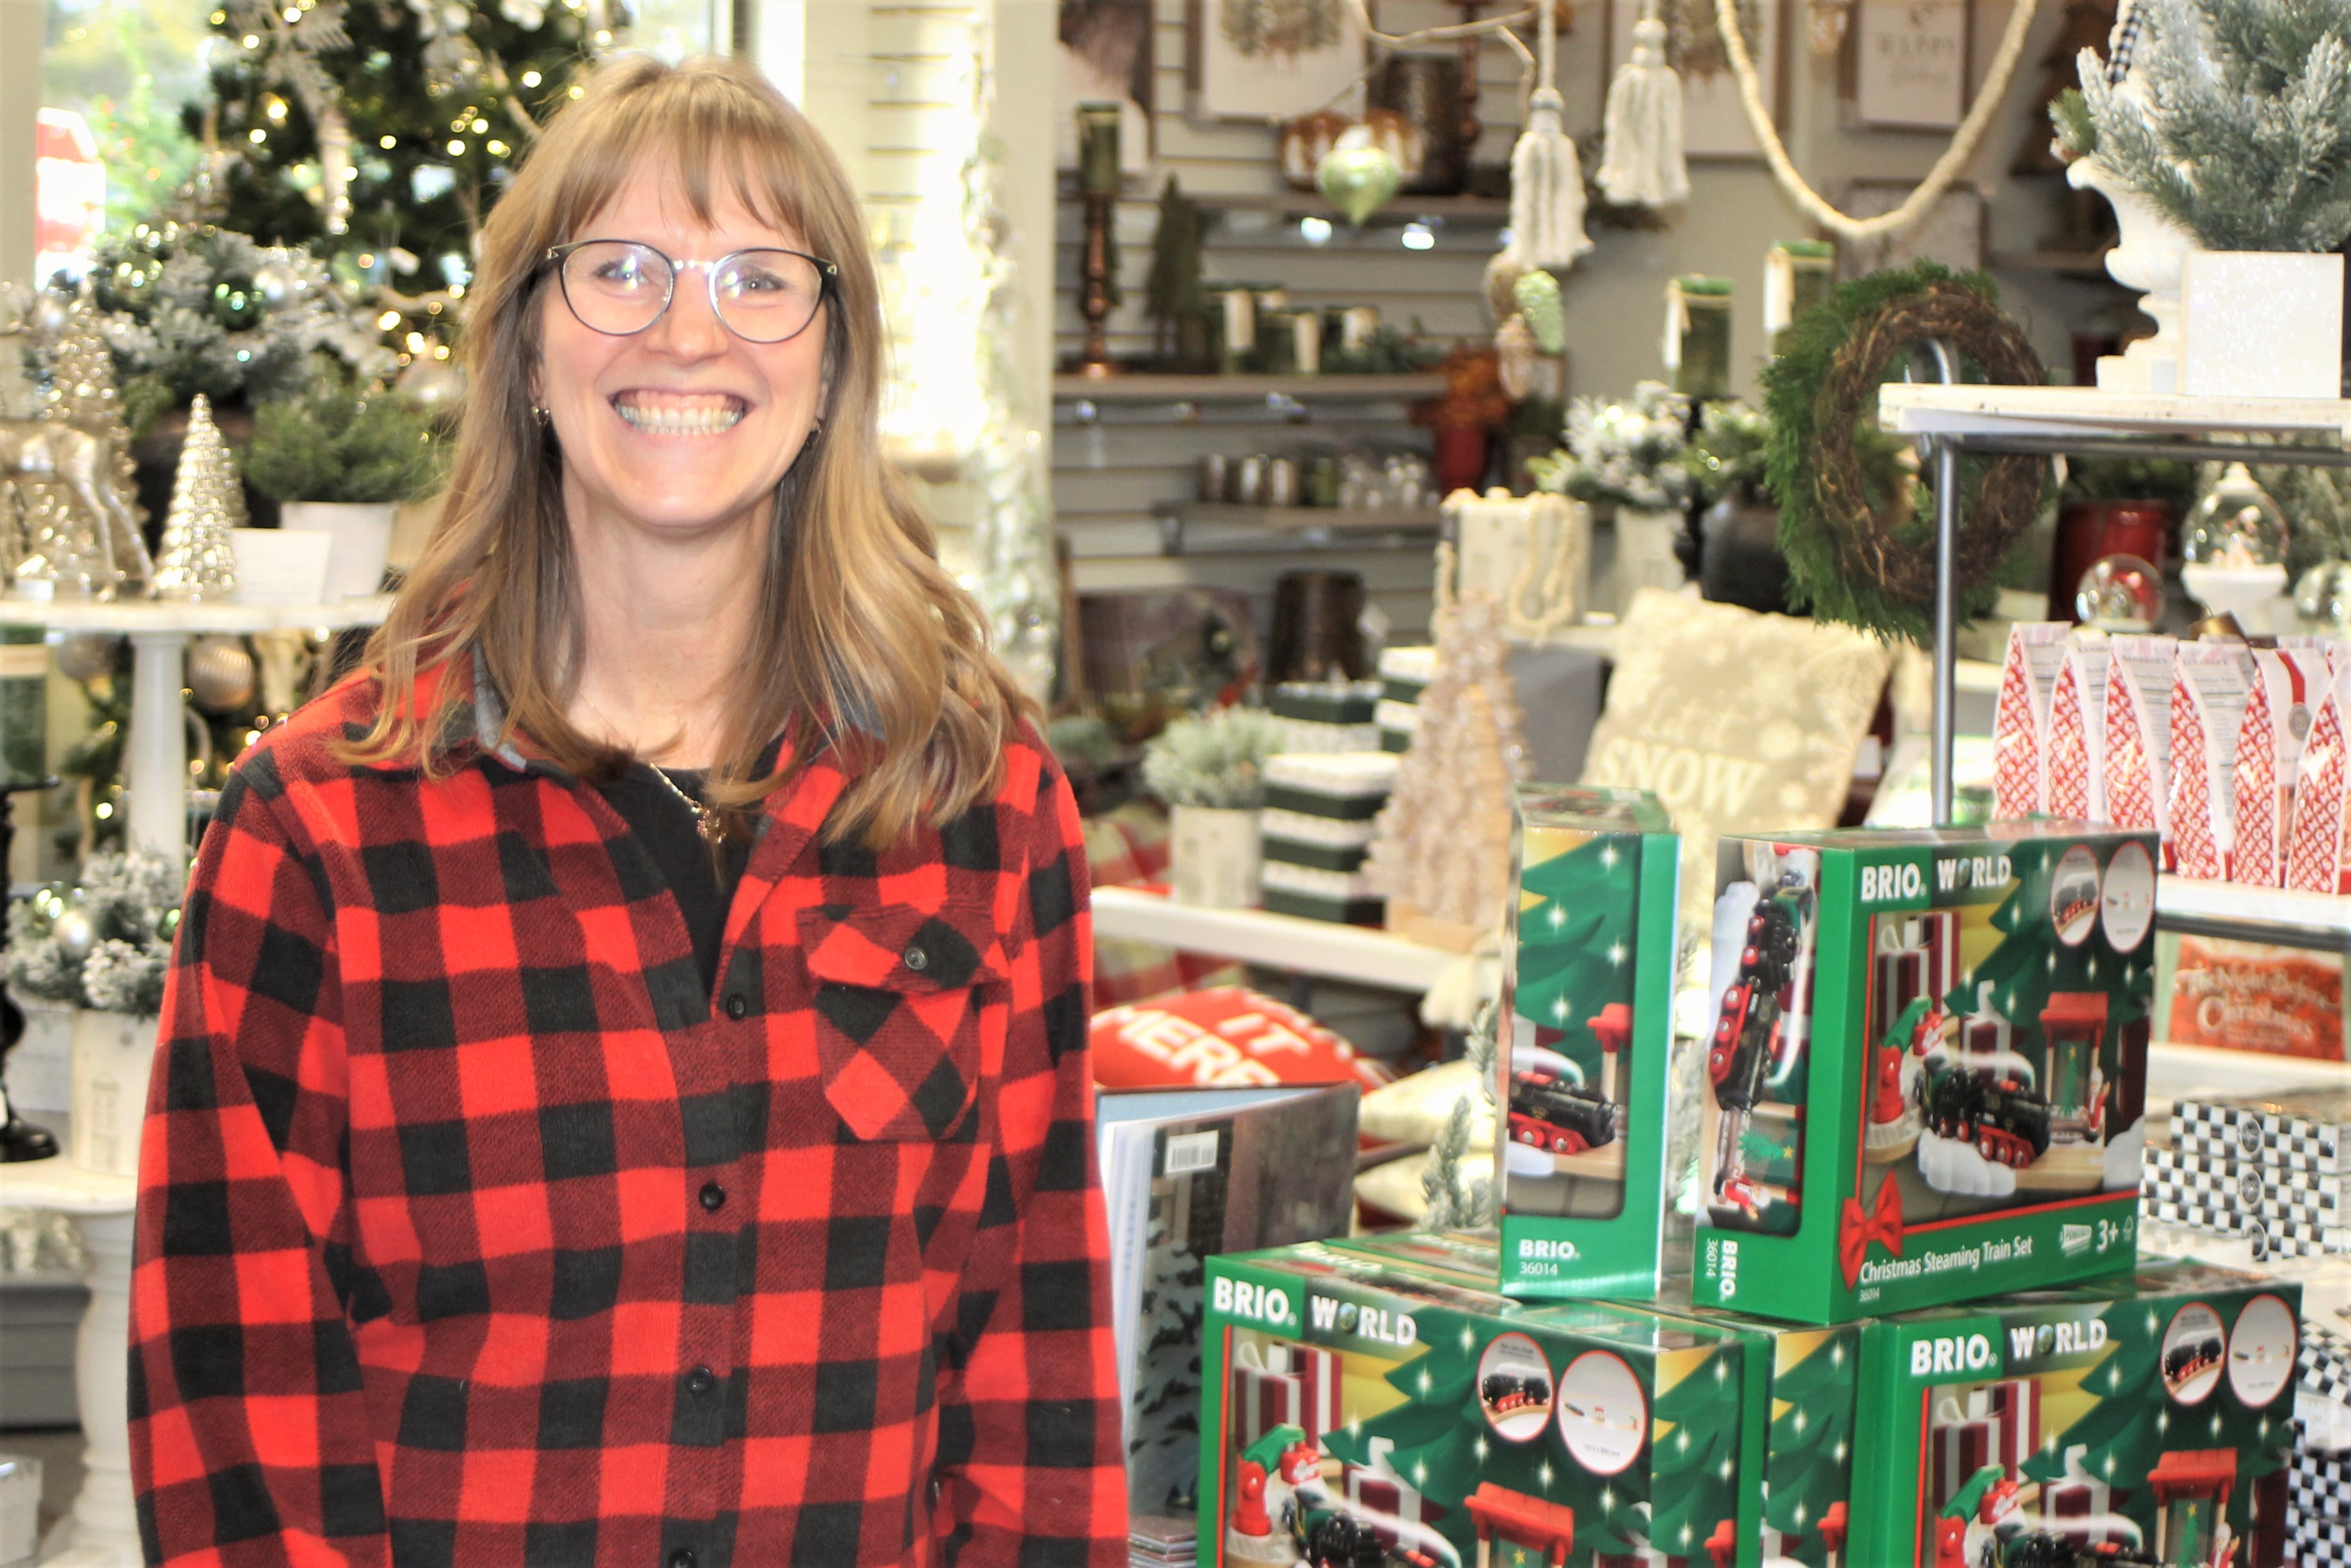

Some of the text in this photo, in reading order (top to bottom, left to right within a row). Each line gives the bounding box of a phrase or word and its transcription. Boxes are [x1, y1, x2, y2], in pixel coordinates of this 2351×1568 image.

[1520, 1261, 1559, 1276] 36014
[1705, 1237, 1719, 1277] 36014
[1859, 1235, 2034, 1284] Christmas Steaming Train Set
[1859, 1286, 1881, 1303] 36014
